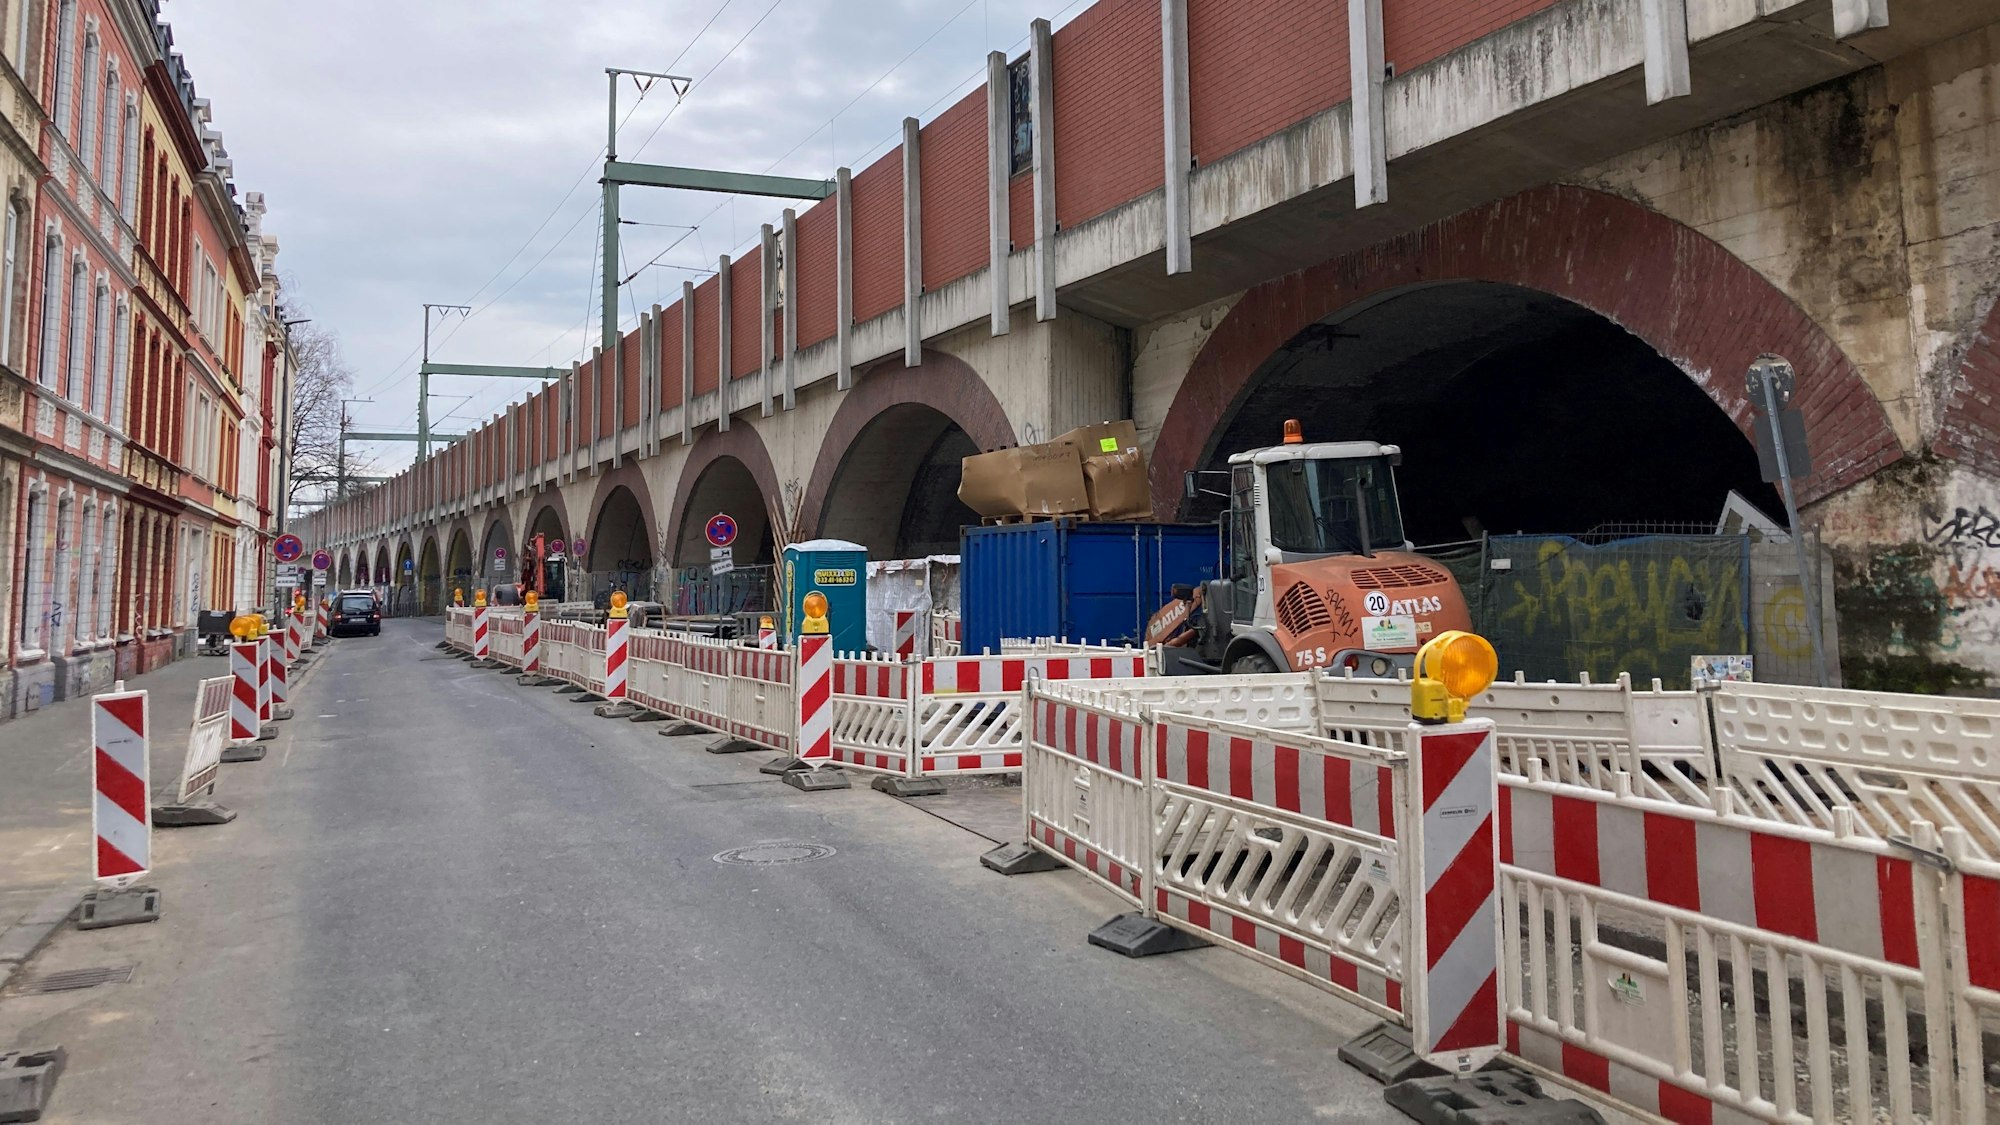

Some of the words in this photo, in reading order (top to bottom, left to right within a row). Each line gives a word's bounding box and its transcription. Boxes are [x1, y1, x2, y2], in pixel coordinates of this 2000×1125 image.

[1369, 596, 1385, 612] 20
[1391, 596, 1442, 615] ATLAS
[1161, 601, 1186, 629] ATLAS
[1296, 650, 1314, 667] 75
[1315, 647, 1327, 664] S
